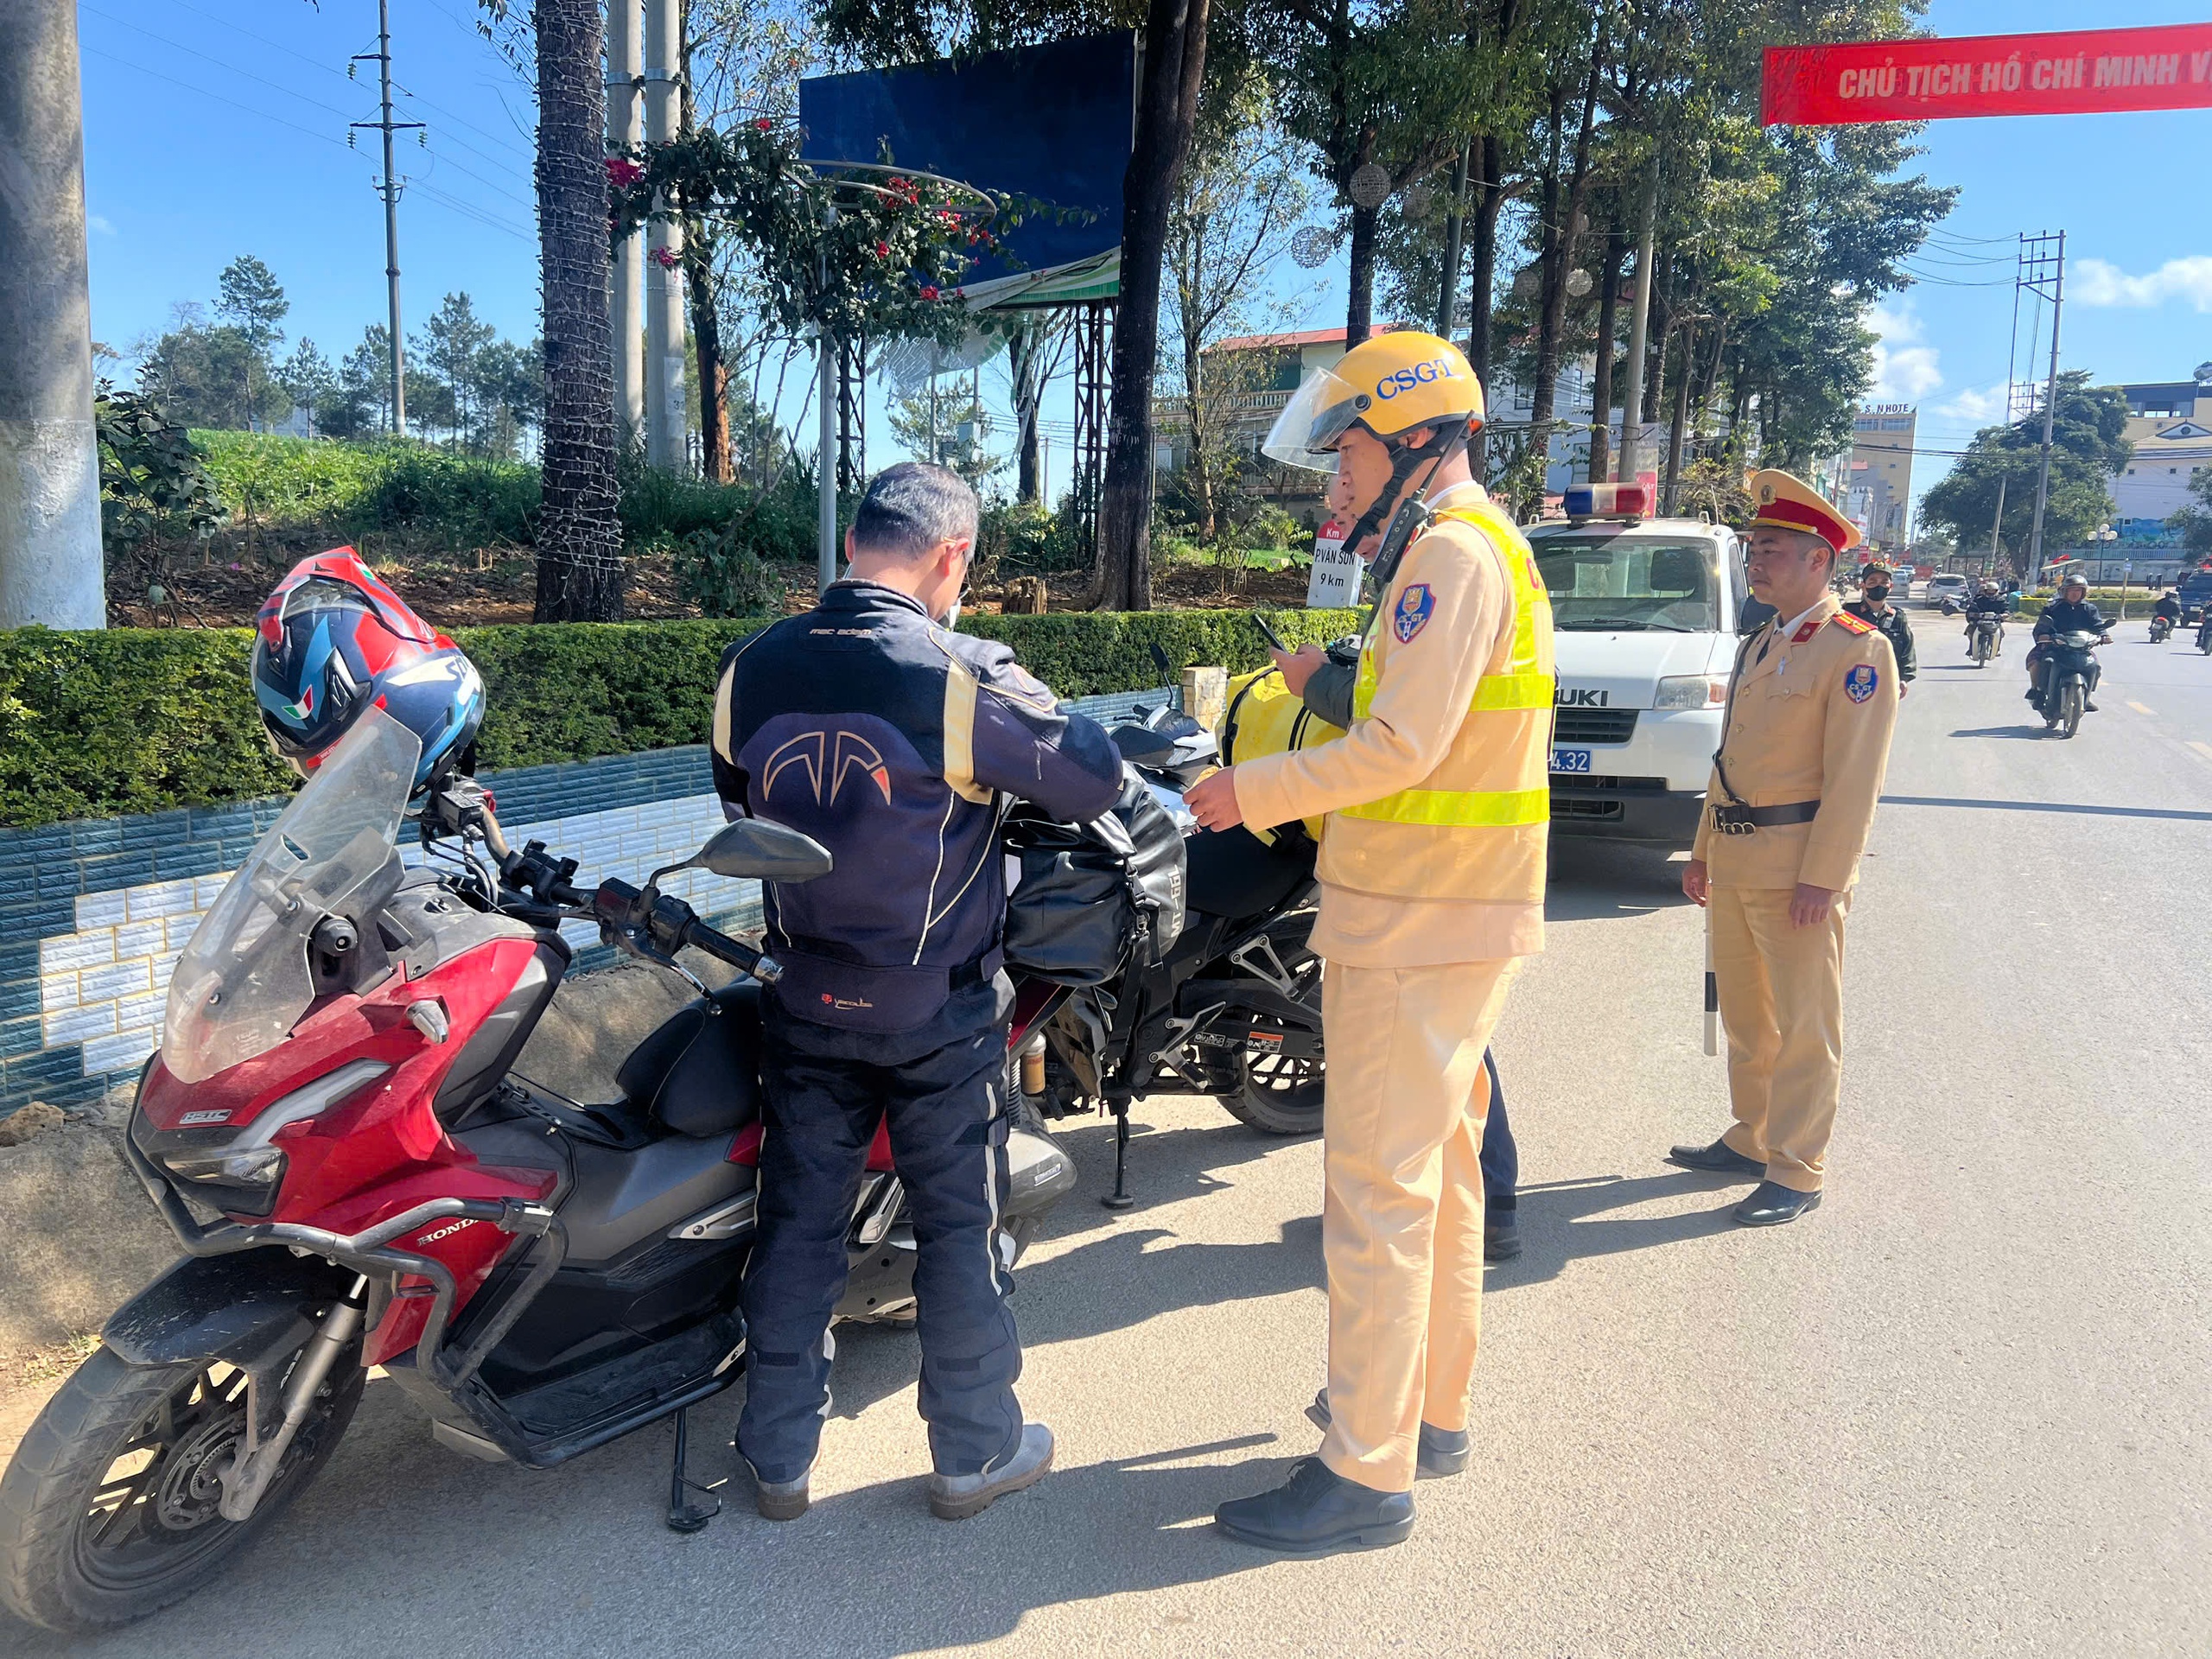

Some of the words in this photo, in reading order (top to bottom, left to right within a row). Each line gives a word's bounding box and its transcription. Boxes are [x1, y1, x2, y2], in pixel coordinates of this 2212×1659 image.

[1839, 57, 1897, 99] CHỦ
[1907, 63, 1971, 103] TỊCH
[1980, 51, 2022, 93] HỒ
[2032, 51, 2086, 91] CHÍ
[2094, 54, 2178, 87] MINH
[2192, 49, 2212, 84] V
[1376, 359, 1454, 400] CSGT
[1326, 528, 1340, 538] Km
[1320, 573, 1326, 585] 9
[1328, 574, 1344, 587] km
[417, 1217, 479, 1247] HOND
